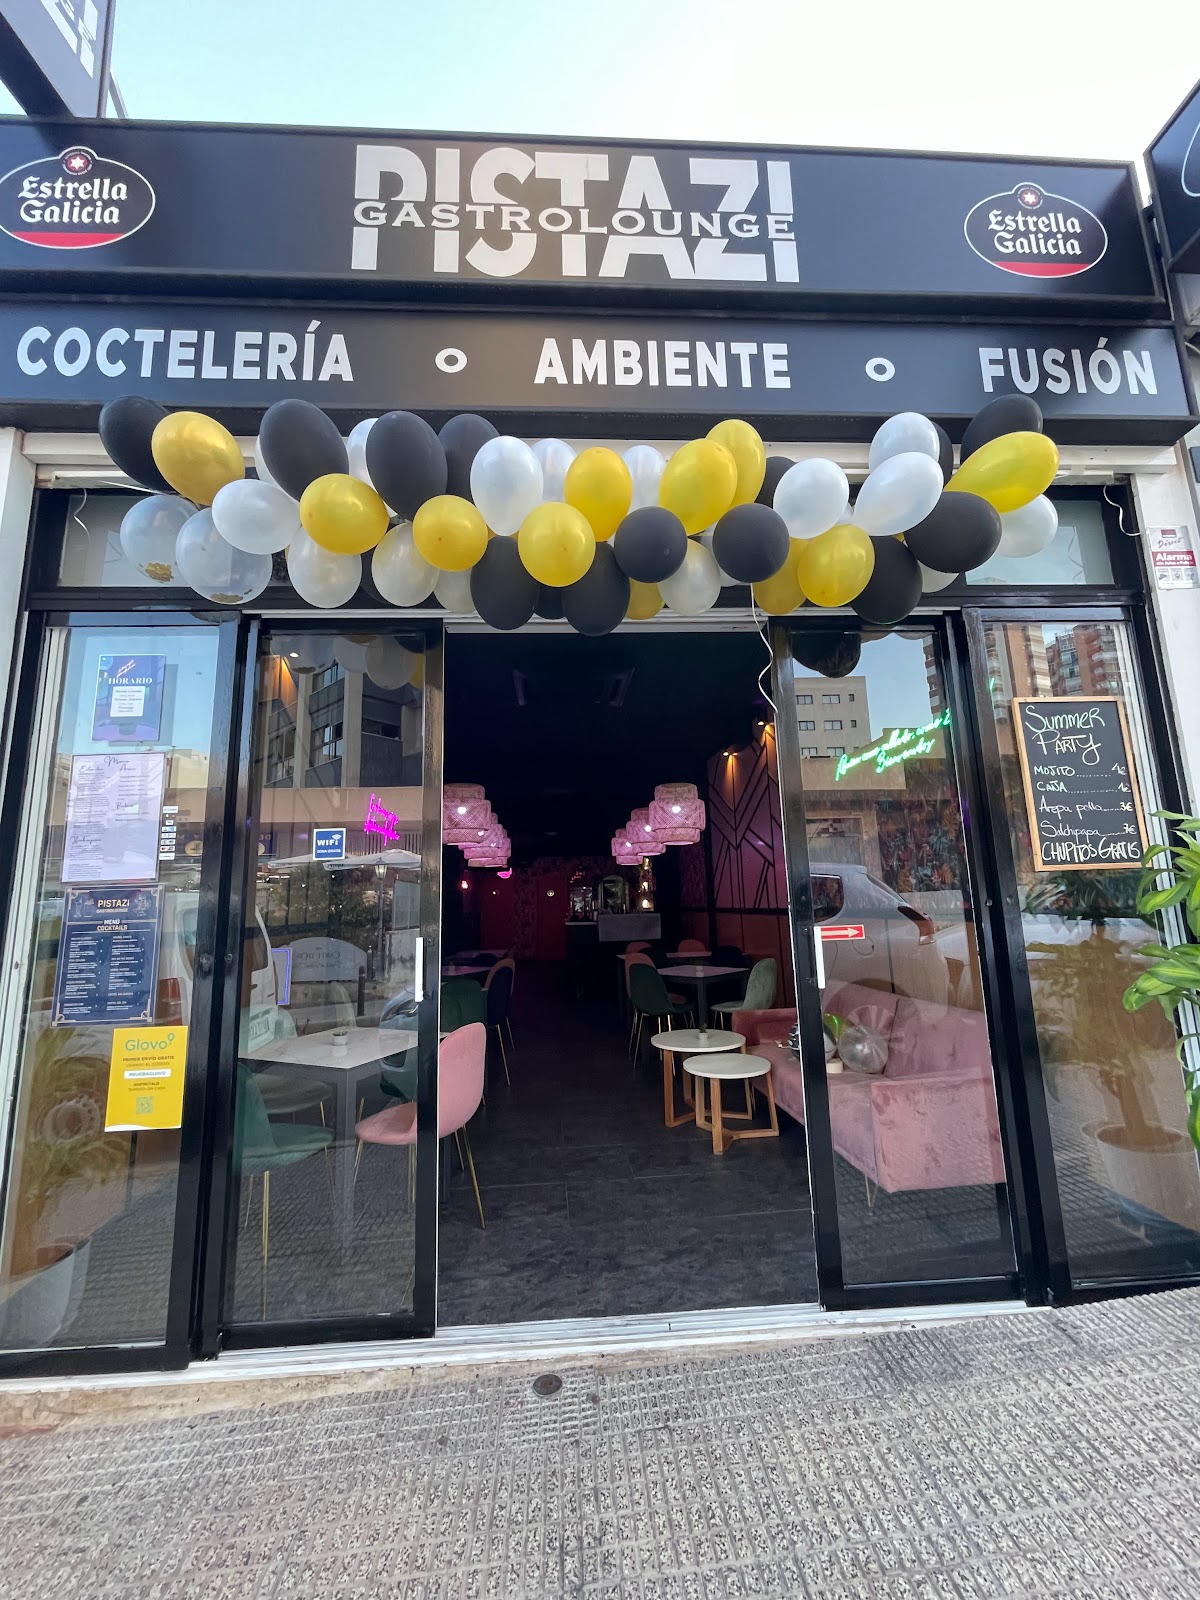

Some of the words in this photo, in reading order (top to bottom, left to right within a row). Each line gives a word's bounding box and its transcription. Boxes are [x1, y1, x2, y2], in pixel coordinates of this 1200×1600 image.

[18, 176, 128, 203] Estrella
[19, 201, 121, 226] Galicia
[351, 144, 800, 283] PISTAZI
[352, 201, 795, 241] GASTROLOUNGE
[987, 208, 1083, 236] Estrella
[993, 231, 1083, 256] Galicia
[16, 320, 354, 382] COCTELERÍA
[533, 338, 792, 389] AMBIENTE
[978, 337, 1158, 396] FUSIÓN
[1155, 552, 1192, 561] Alarma
[108, 677, 153, 685] HORARIO
[1033, 765, 1076, 777] MOJITO
[1119, 801, 1133, 811] 3€
[1041, 841, 1098, 863] CHUPITOS
[1098, 836, 1141, 860] GRATIS
[97, 899, 130, 908] PISTAZI
[125, 1038, 168, 1051] Glovo
